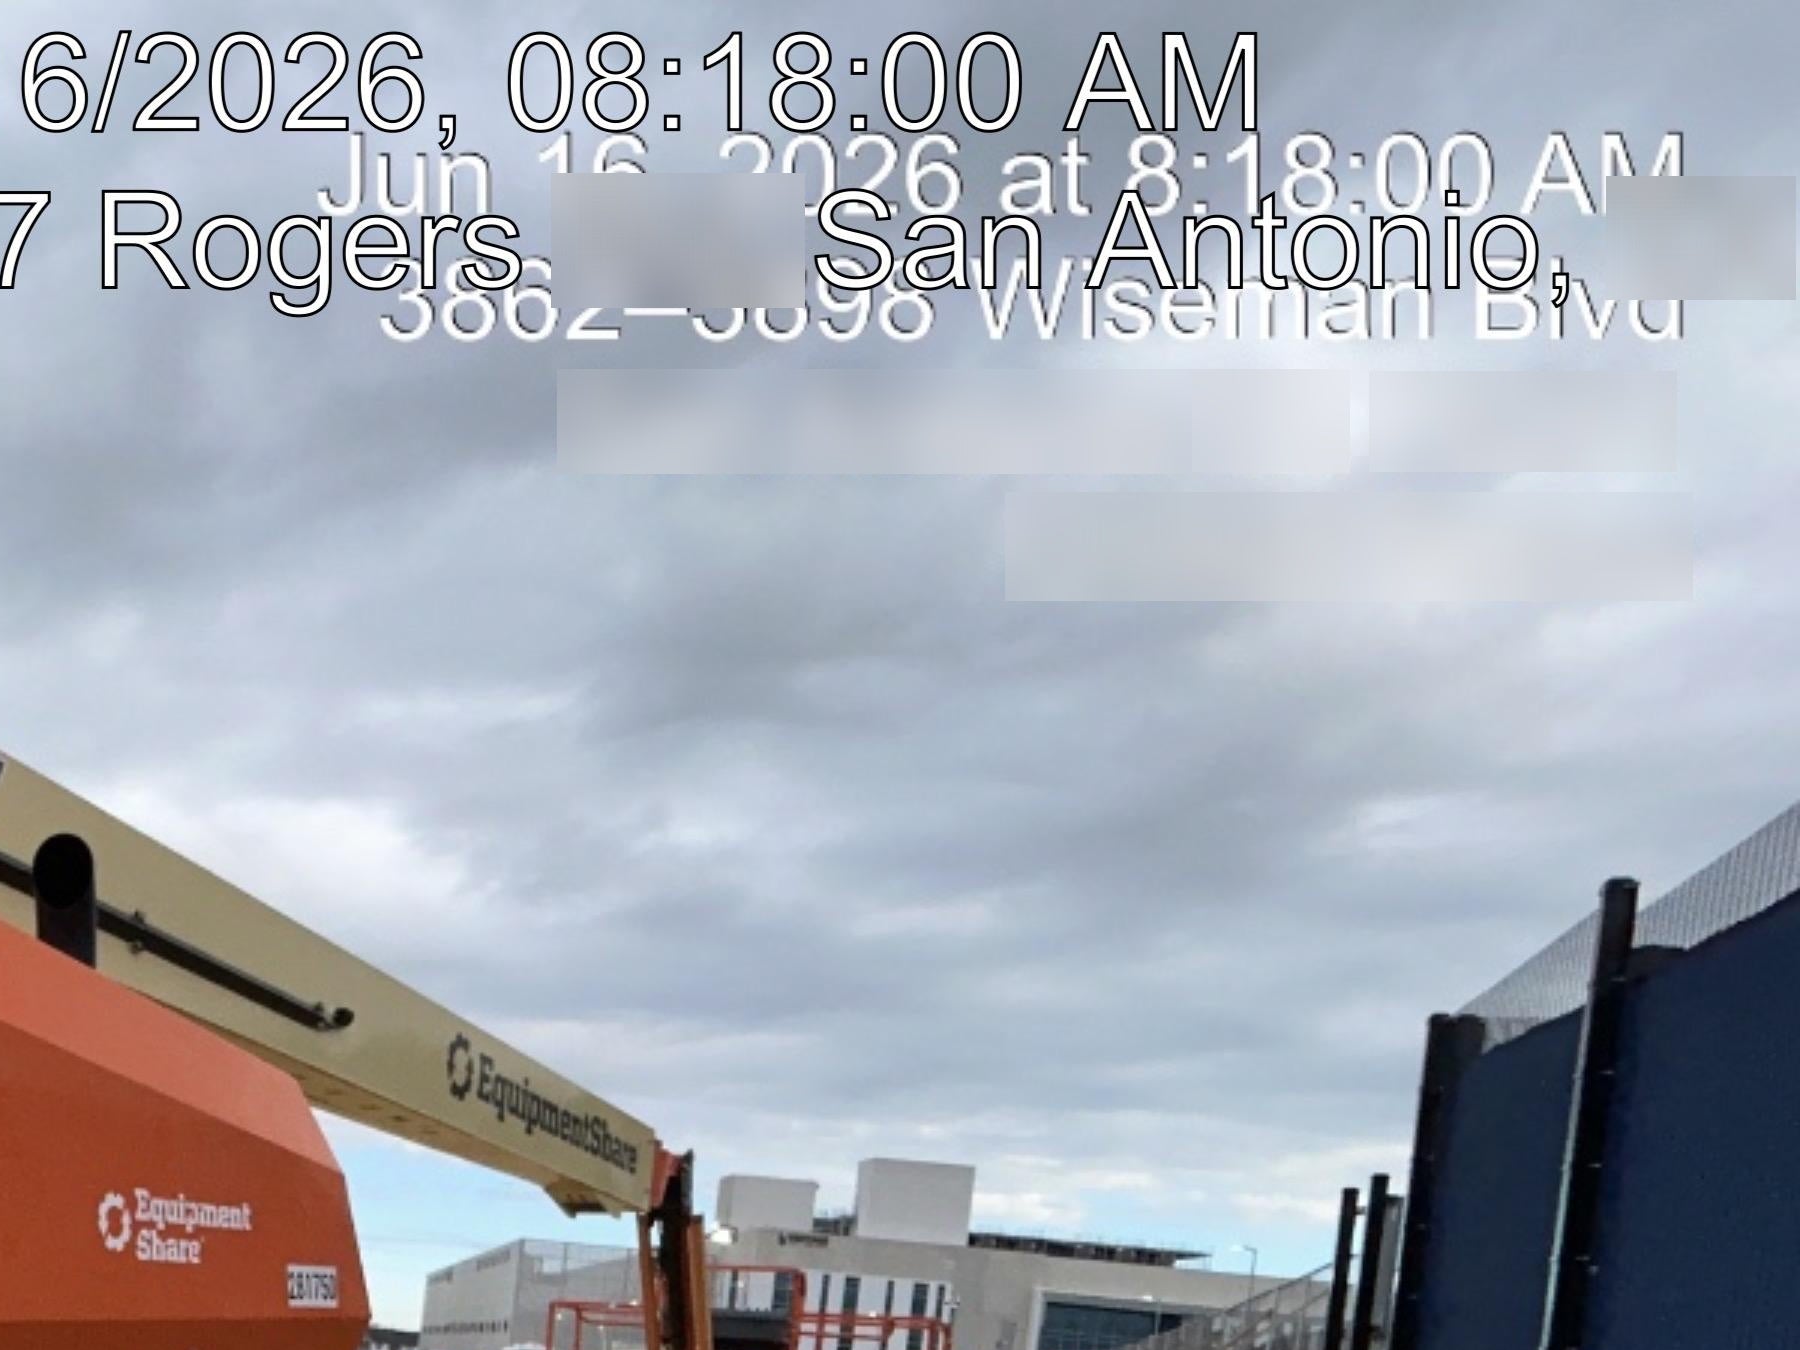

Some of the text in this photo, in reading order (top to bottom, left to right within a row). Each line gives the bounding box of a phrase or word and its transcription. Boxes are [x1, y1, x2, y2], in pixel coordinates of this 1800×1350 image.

[477, 1053, 638, 1175] EquipmentShare
[134, 1187, 253, 1233] Equipment
[135, 1229, 202, 1264] Share
